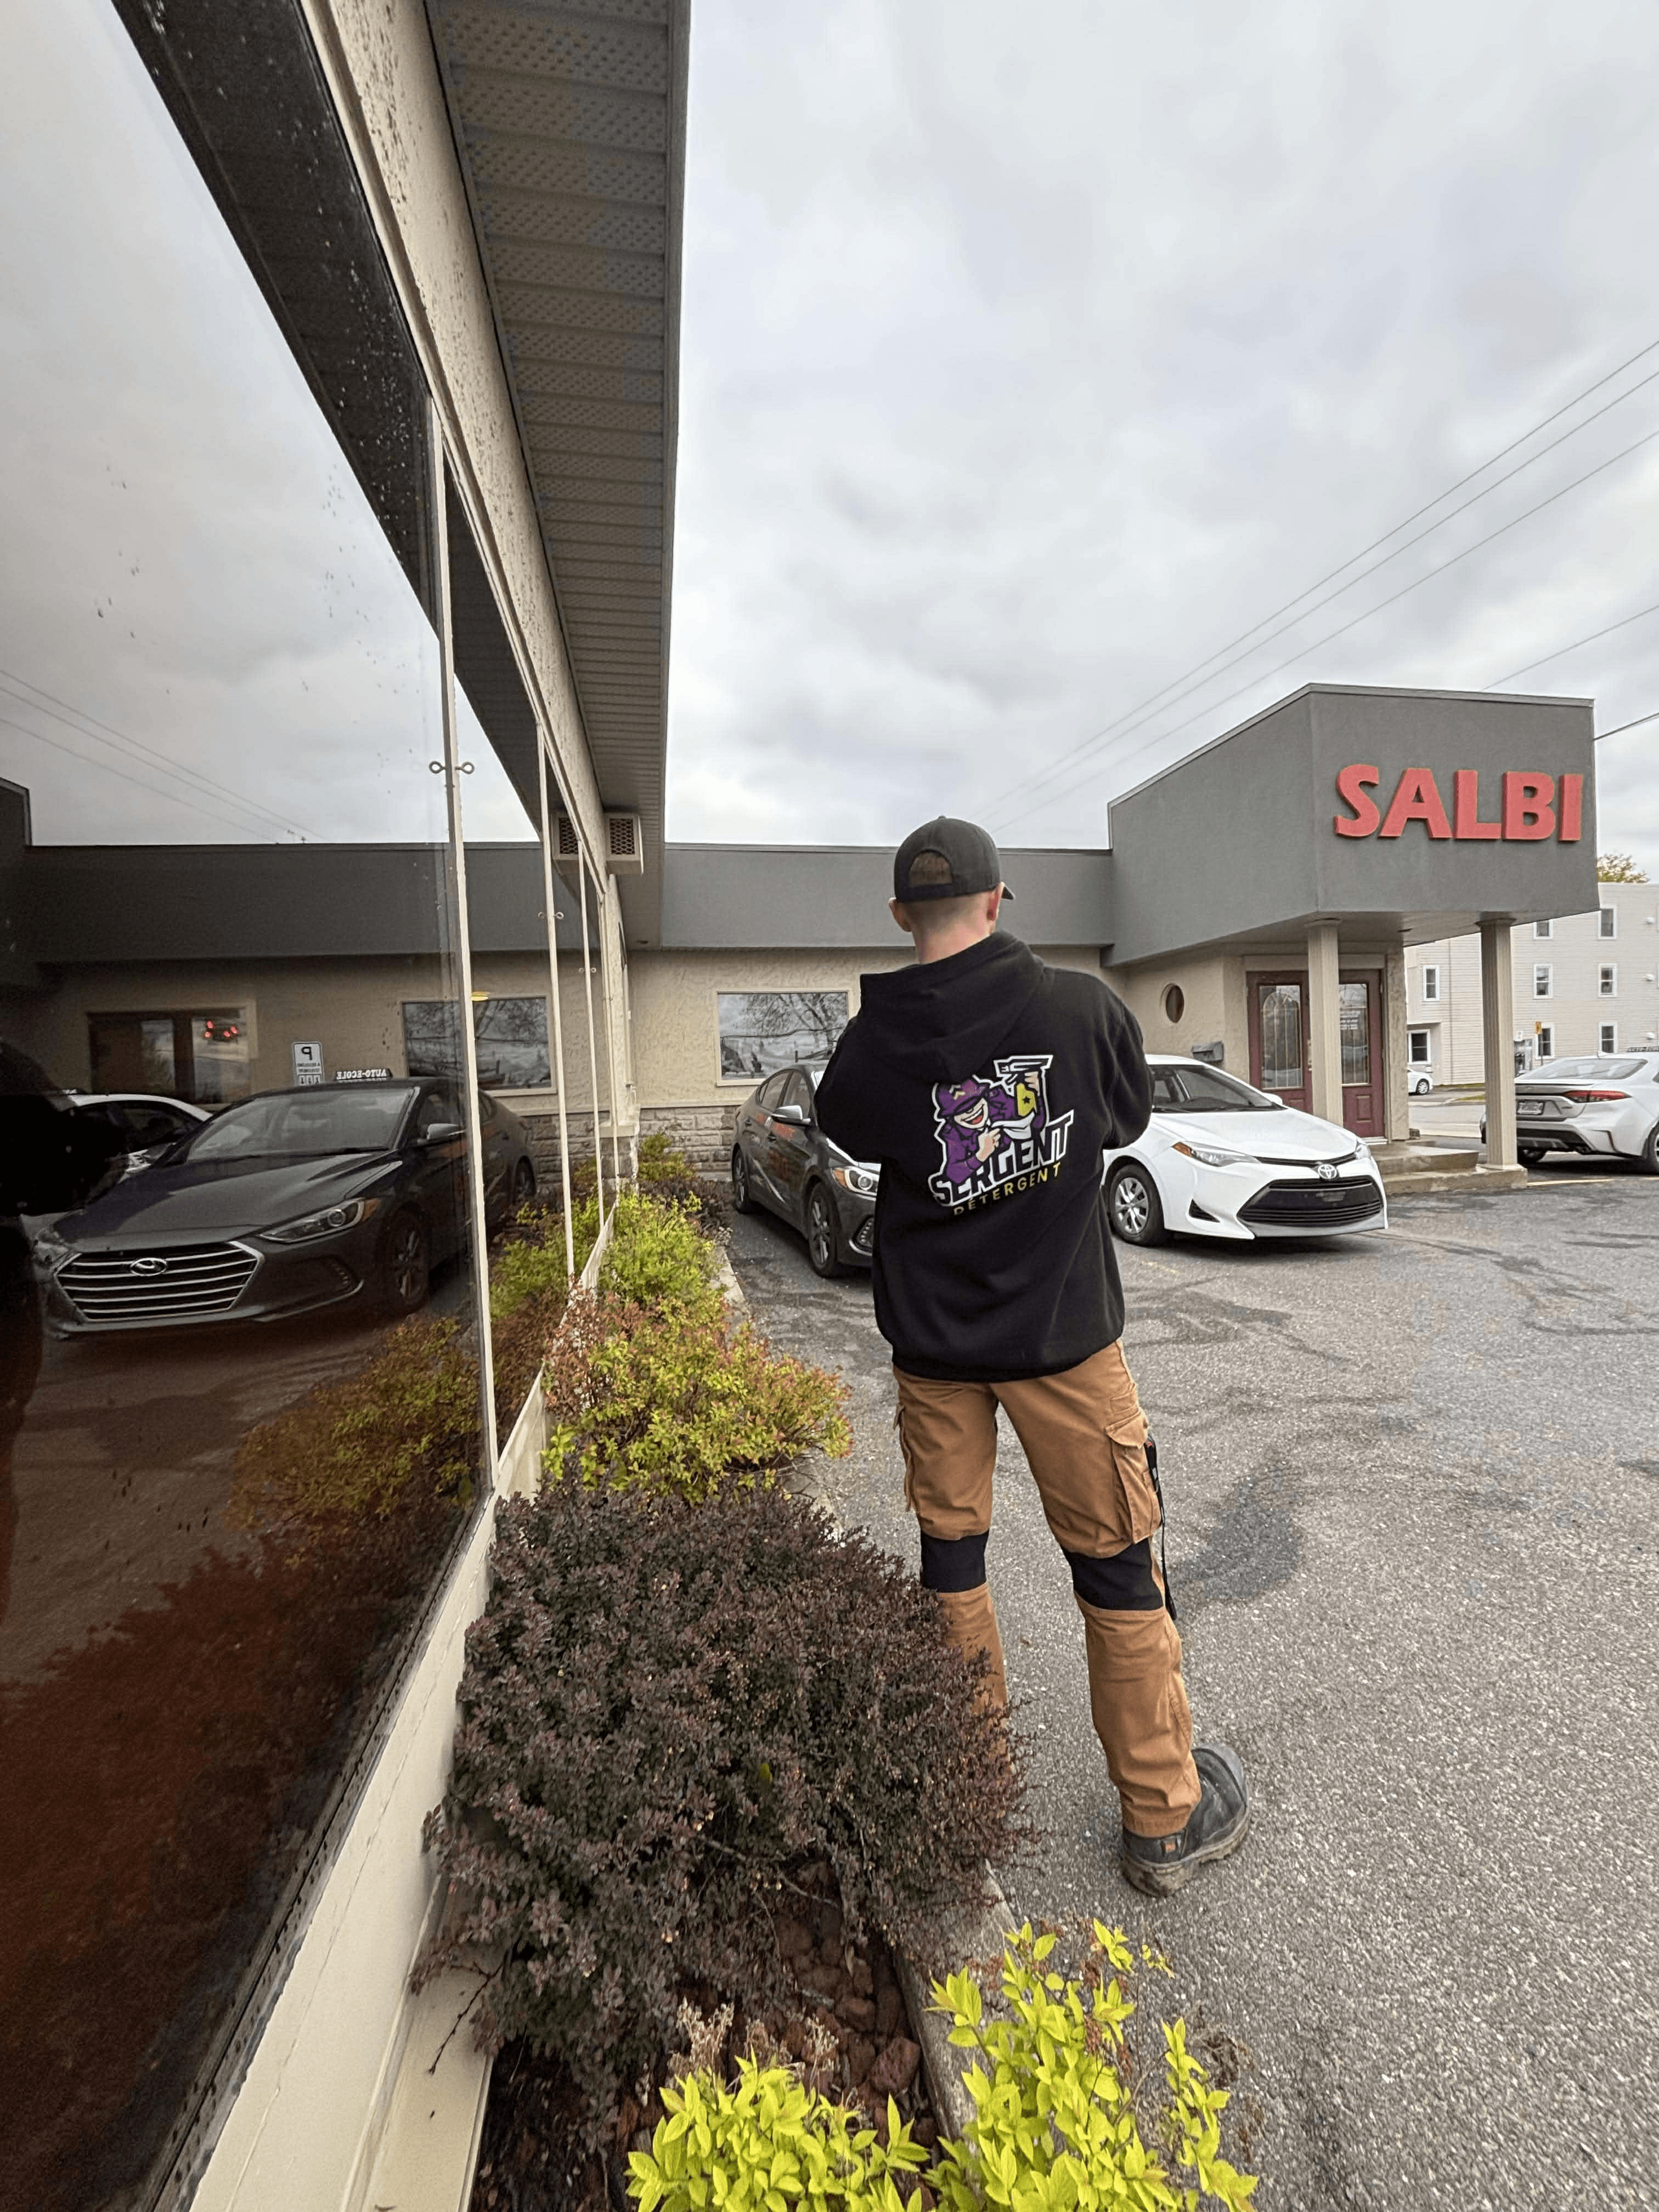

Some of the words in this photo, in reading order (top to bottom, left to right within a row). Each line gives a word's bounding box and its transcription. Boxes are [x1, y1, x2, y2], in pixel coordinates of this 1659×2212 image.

[1334, 763, 1584, 842] SALBI
[928, 1109, 1074, 1207] SERGENT
[953, 1161, 1061, 1216] DÉTERGENT
